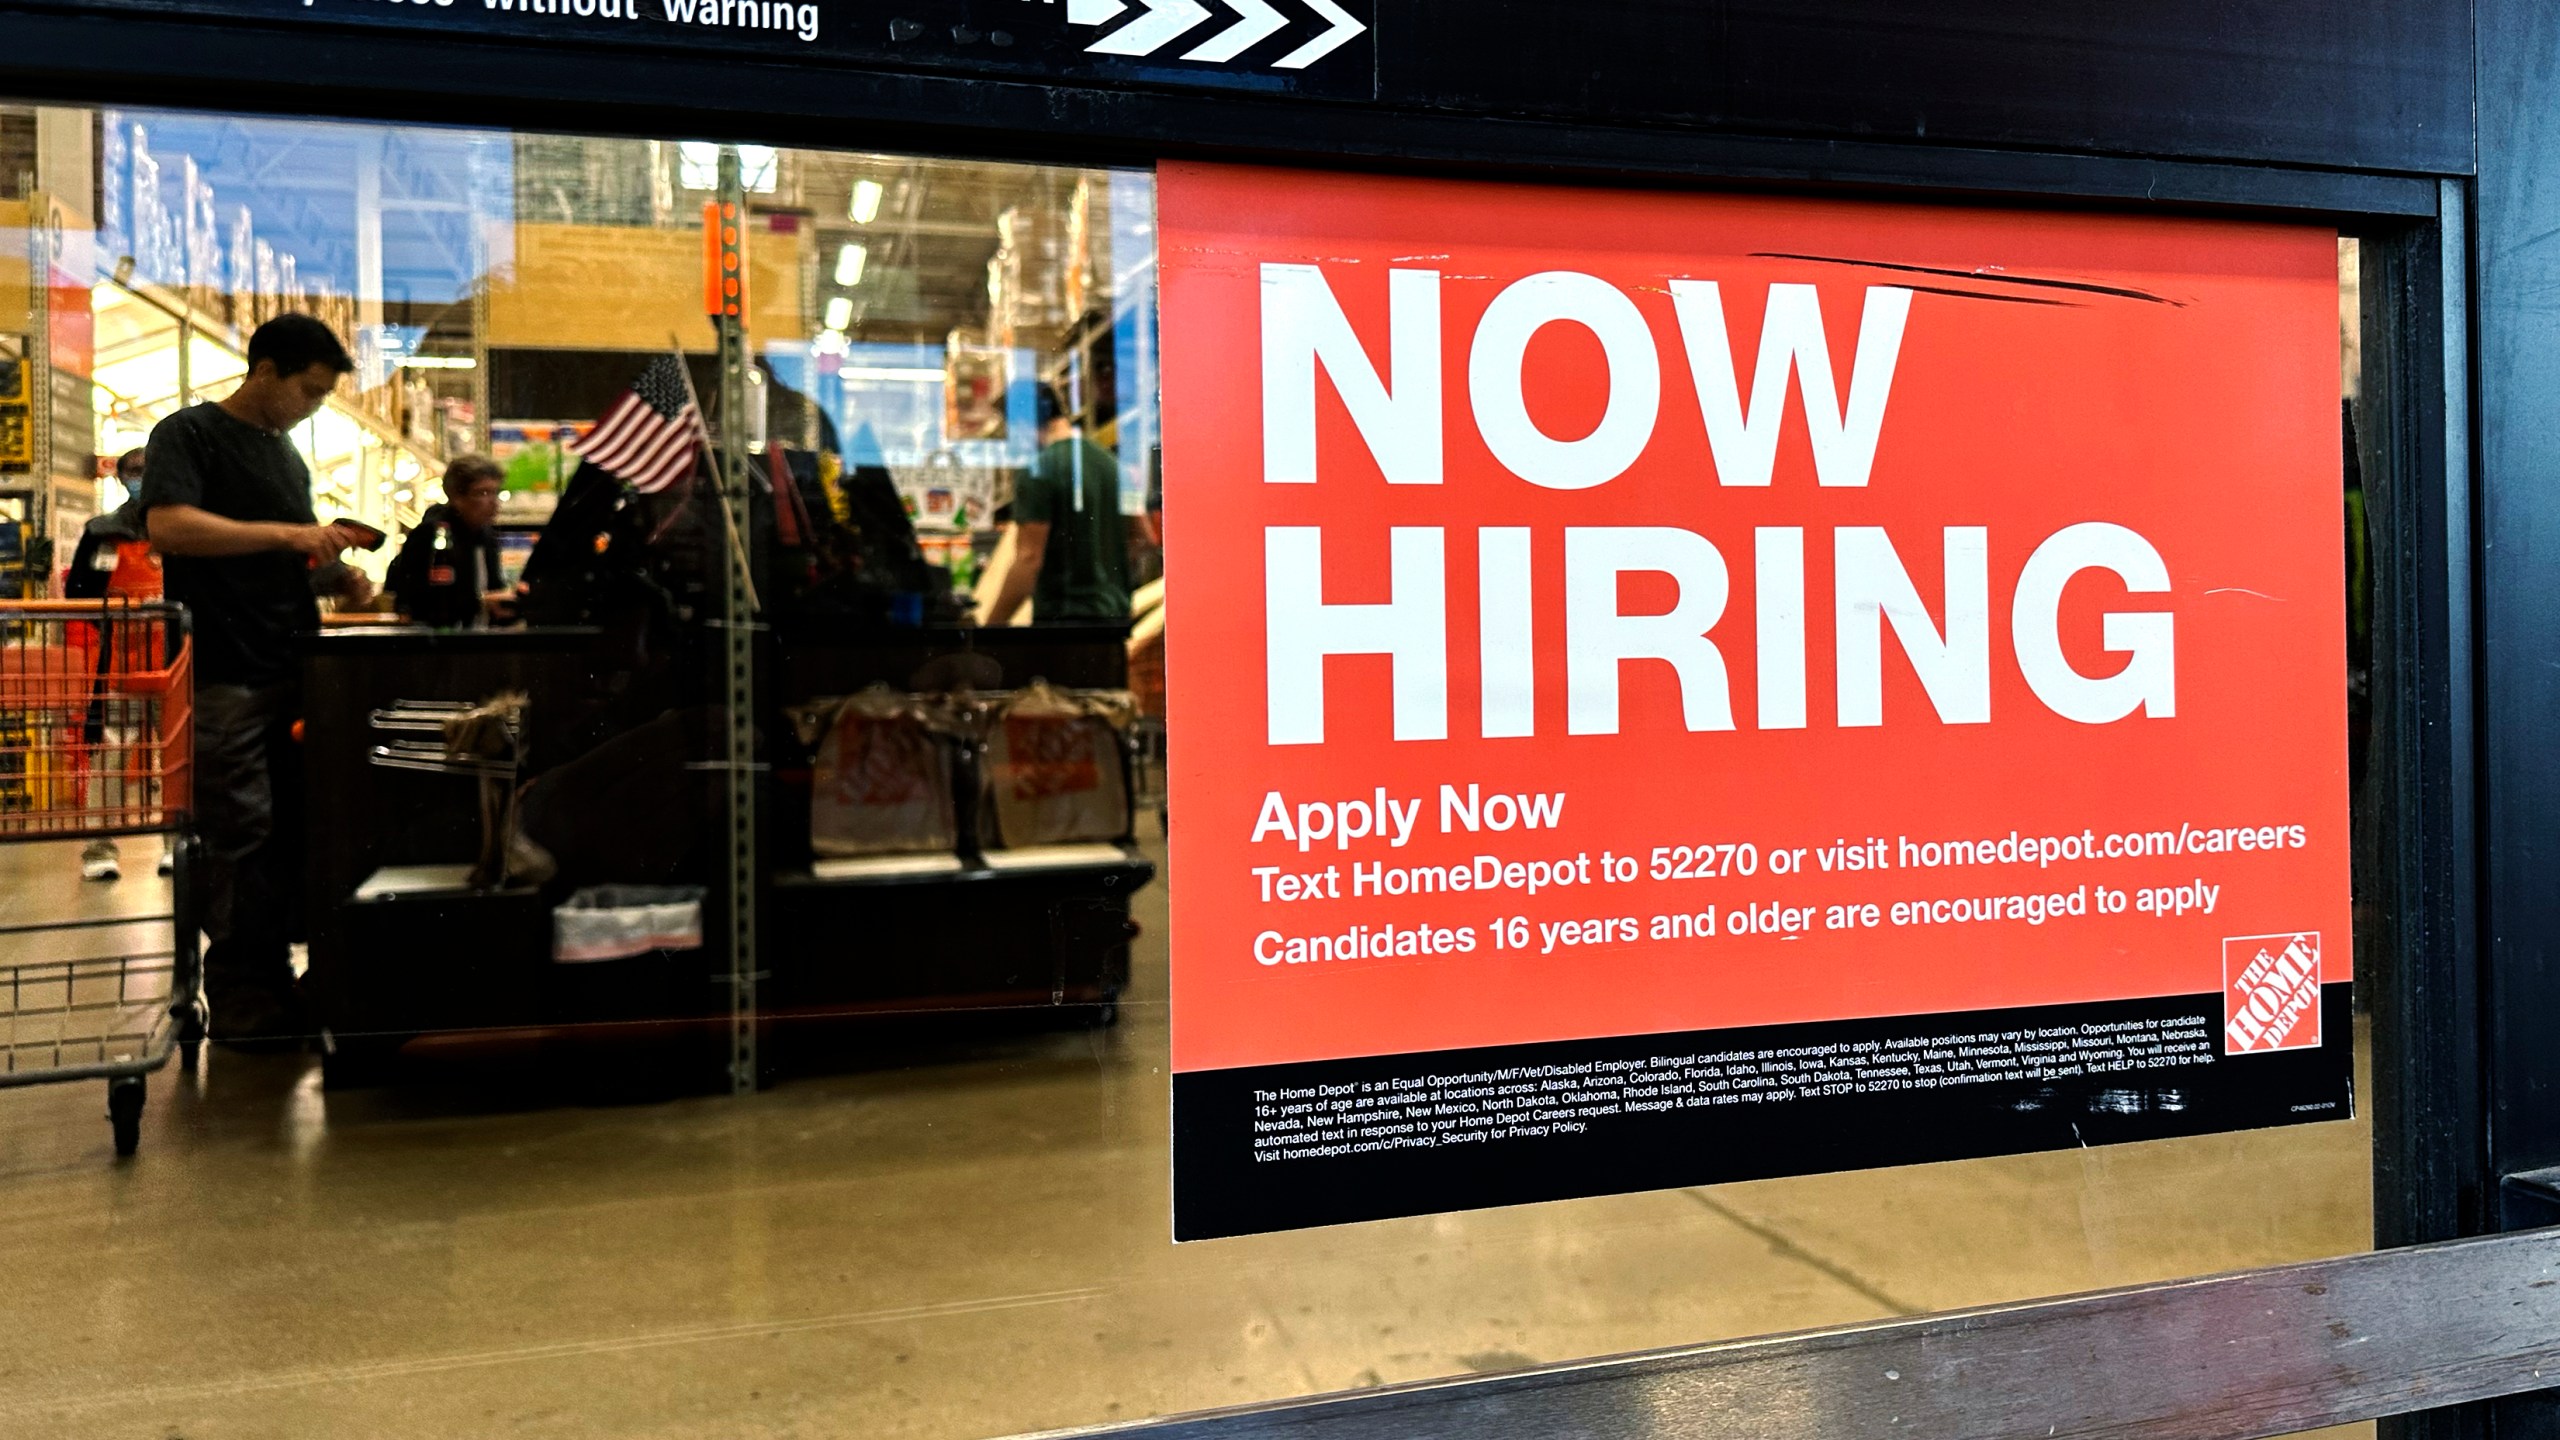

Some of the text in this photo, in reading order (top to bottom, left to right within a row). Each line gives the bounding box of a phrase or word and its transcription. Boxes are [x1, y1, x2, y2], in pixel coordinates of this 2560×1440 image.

[663, 0, 819, 42] warning
[1260, 263, 1913, 489] NOW
[1265, 522, 2175, 745] HIRING
[1251, 783, 1565, 852] Apply Now
[1252, 822, 2306, 902] Text HomeDepot to 52270 or visit homedepot.com/careers
[1254, 878, 2220, 966] Candidates 16 years and older are encouraged to apply
[2227, 935, 2318, 1051] HOME
[2234, 948, 2275, 995] THE
[2263, 975, 2318, 1048] DEPOT
[1253, 1090, 1277, 1102] The
[1280, 1088, 1316, 1100] Home
[1361, 1082, 1372, 1093] is
[1374, 1082, 1389, 1092] an
[1392, 1077, 1424, 1092] Equal
[1426, 1063, 1592, 1089] Opportunity/M/F/Vet/Disabled
[1595, 1059, 1648, 1074] Employer.
[1650, 1055, 1695, 1069] Bilingual
[1697, 1051, 1756, 1064] candidates
[1757, 1050, 1775, 1060] are
[1776, 1043, 1838, 1058] encouraged
[1839, 1043, 1851, 1053] to
[1852, 1040, 1882, 1054] apply.
[1884, 1036, 1930, 1050] Available
[1931, 1034, 1977, 1049] positions
[1978, 1033, 1999, 1044] may
[2001, 1031, 2022, 1042] vary
[2024, 1028, 2037, 1041] by
[2080, 1021, 2145, 1036] Opportunities
[2145, 1019, 2159, 1029] for
[2160, 1015, 2206, 1028] candidate
[1254, 1117, 1304, 1133] Nevada,
[1307, 1115, 1334, 1128] New
[1337, 1108, 1403, 1125] Hampshire,
[1405, 1106, 1432, 1118] New
[1434, 1102, 1479, 1116] Mexico,
[1482, 1098, 1514, 1111] North
[1516, 1094, 1559, 1108] Dakota,
[1561, 1090, 1621, 1104] Oklahoma,
[1623, 1085, 1659, 1099] Rhode
[1660, 1082, 1696, 1095] Island,
[1698, 1079, 1730, 1092] South
[1732, 1076, 1778, 1090] Carolina,
[1780, 1072, 1812, 1086] South
[1813, 1070, 1853, 1083] Dakota,
[1855, 1066, 1911, 1079] Tennessee,
[2020, 1054, 2057, 1067] Virginia
[2058, 1050, 2077, 1063] and
[2127, 1046, 2146, 1057] You
[2146, 1043, 2163, 1055] will
[2163, 1042, 2197, 1054] receive
[2197, 1041, 2211, 1051] an
[1255, 1104, 1278, 1117] 16+
[1280, 1103, 1313, 1118] years
[1315, 1099, 1328, 1112] of
[1330, 1099, 1353, 1112] age
[1355, 1097, 1375, 1108] are
[1376, 1091, 1428, 1106] available
[1429, 1089, 1442, 1101] at
[1444, 1086, 1495, 1100] locations
[1497, 1083, 1538, 1095] across:
[1540, 1078, 1581, 1092] Alaska,
[1582, 1073, 1629, 1088] Arizona,
[1630, 1069, 1682, 1084] Colorado,
[1684, 1066, 1724, 1079] Florida,
[1726, 1064, 1759, 1076] Idaho,
[1761, 1060, 1797, 1073] Illinois,
[1799, 1059, 1827, 1070] Iowa,
[1829, 1056, 1870, 1068] Kansas,
[1872, 1050, 1921, 1064] Kentucky,
[1253, 1122, 1588, 1163] Visit homedepot.com/c/Privacy_Security for Privacy Policy.
[1254, 1130, 1319, 1148] automated
[1321, 1128, 1345, 1141] text
[1346, 1127, 1358, 1139] in
[1360, 1123, 1414, 1138] response
[1416, 1121, 1429, 1132] to
[1430, 1119, 1457, 1133] your
[1459, 1115, 1494, 1128] Home
[1496, 1111, 1530, 1125] Depot
[1532, 1108, 1576, 1121] Careers
[1578, 1103, 1622, 1118] request.
[1624, 1099, 1674, 1113] Message
[1675, 1097, 1684, 1108] &
[1685, 1096, 1711, 1107] data
[1712, 1094, 1740, 1105] rates
[1741, 1092, 1764, 1104] may
[1765, 1088, 1797, 1102] apply.
[1798, 1085, 1821, 1098] Text
[1822, 1083, 1854, 1096] STOP
[1855, 1082, 1867, 1093] to
[1868, 1079, 1900, 1092] 52270
[1901, 1078, 1913, 1089] to
[1914, 1077, 1938, 1089] stop
[1938, 1072, 2003, 1088] (confirmation
[2004, 1069, 2024, 1081] text
[2025, 1067, 2042, 1079] will
[2043, 1067, 2056, 1077] be
[2086, 1062, 2106, 1073] Text
[2107, 1059, 2135, 1071] HELP
[2135, 1059, 2147, 1069] to
[2147, 1056, 2177, 1068] 52270
[2178, 1055, 2192, 1065] for
